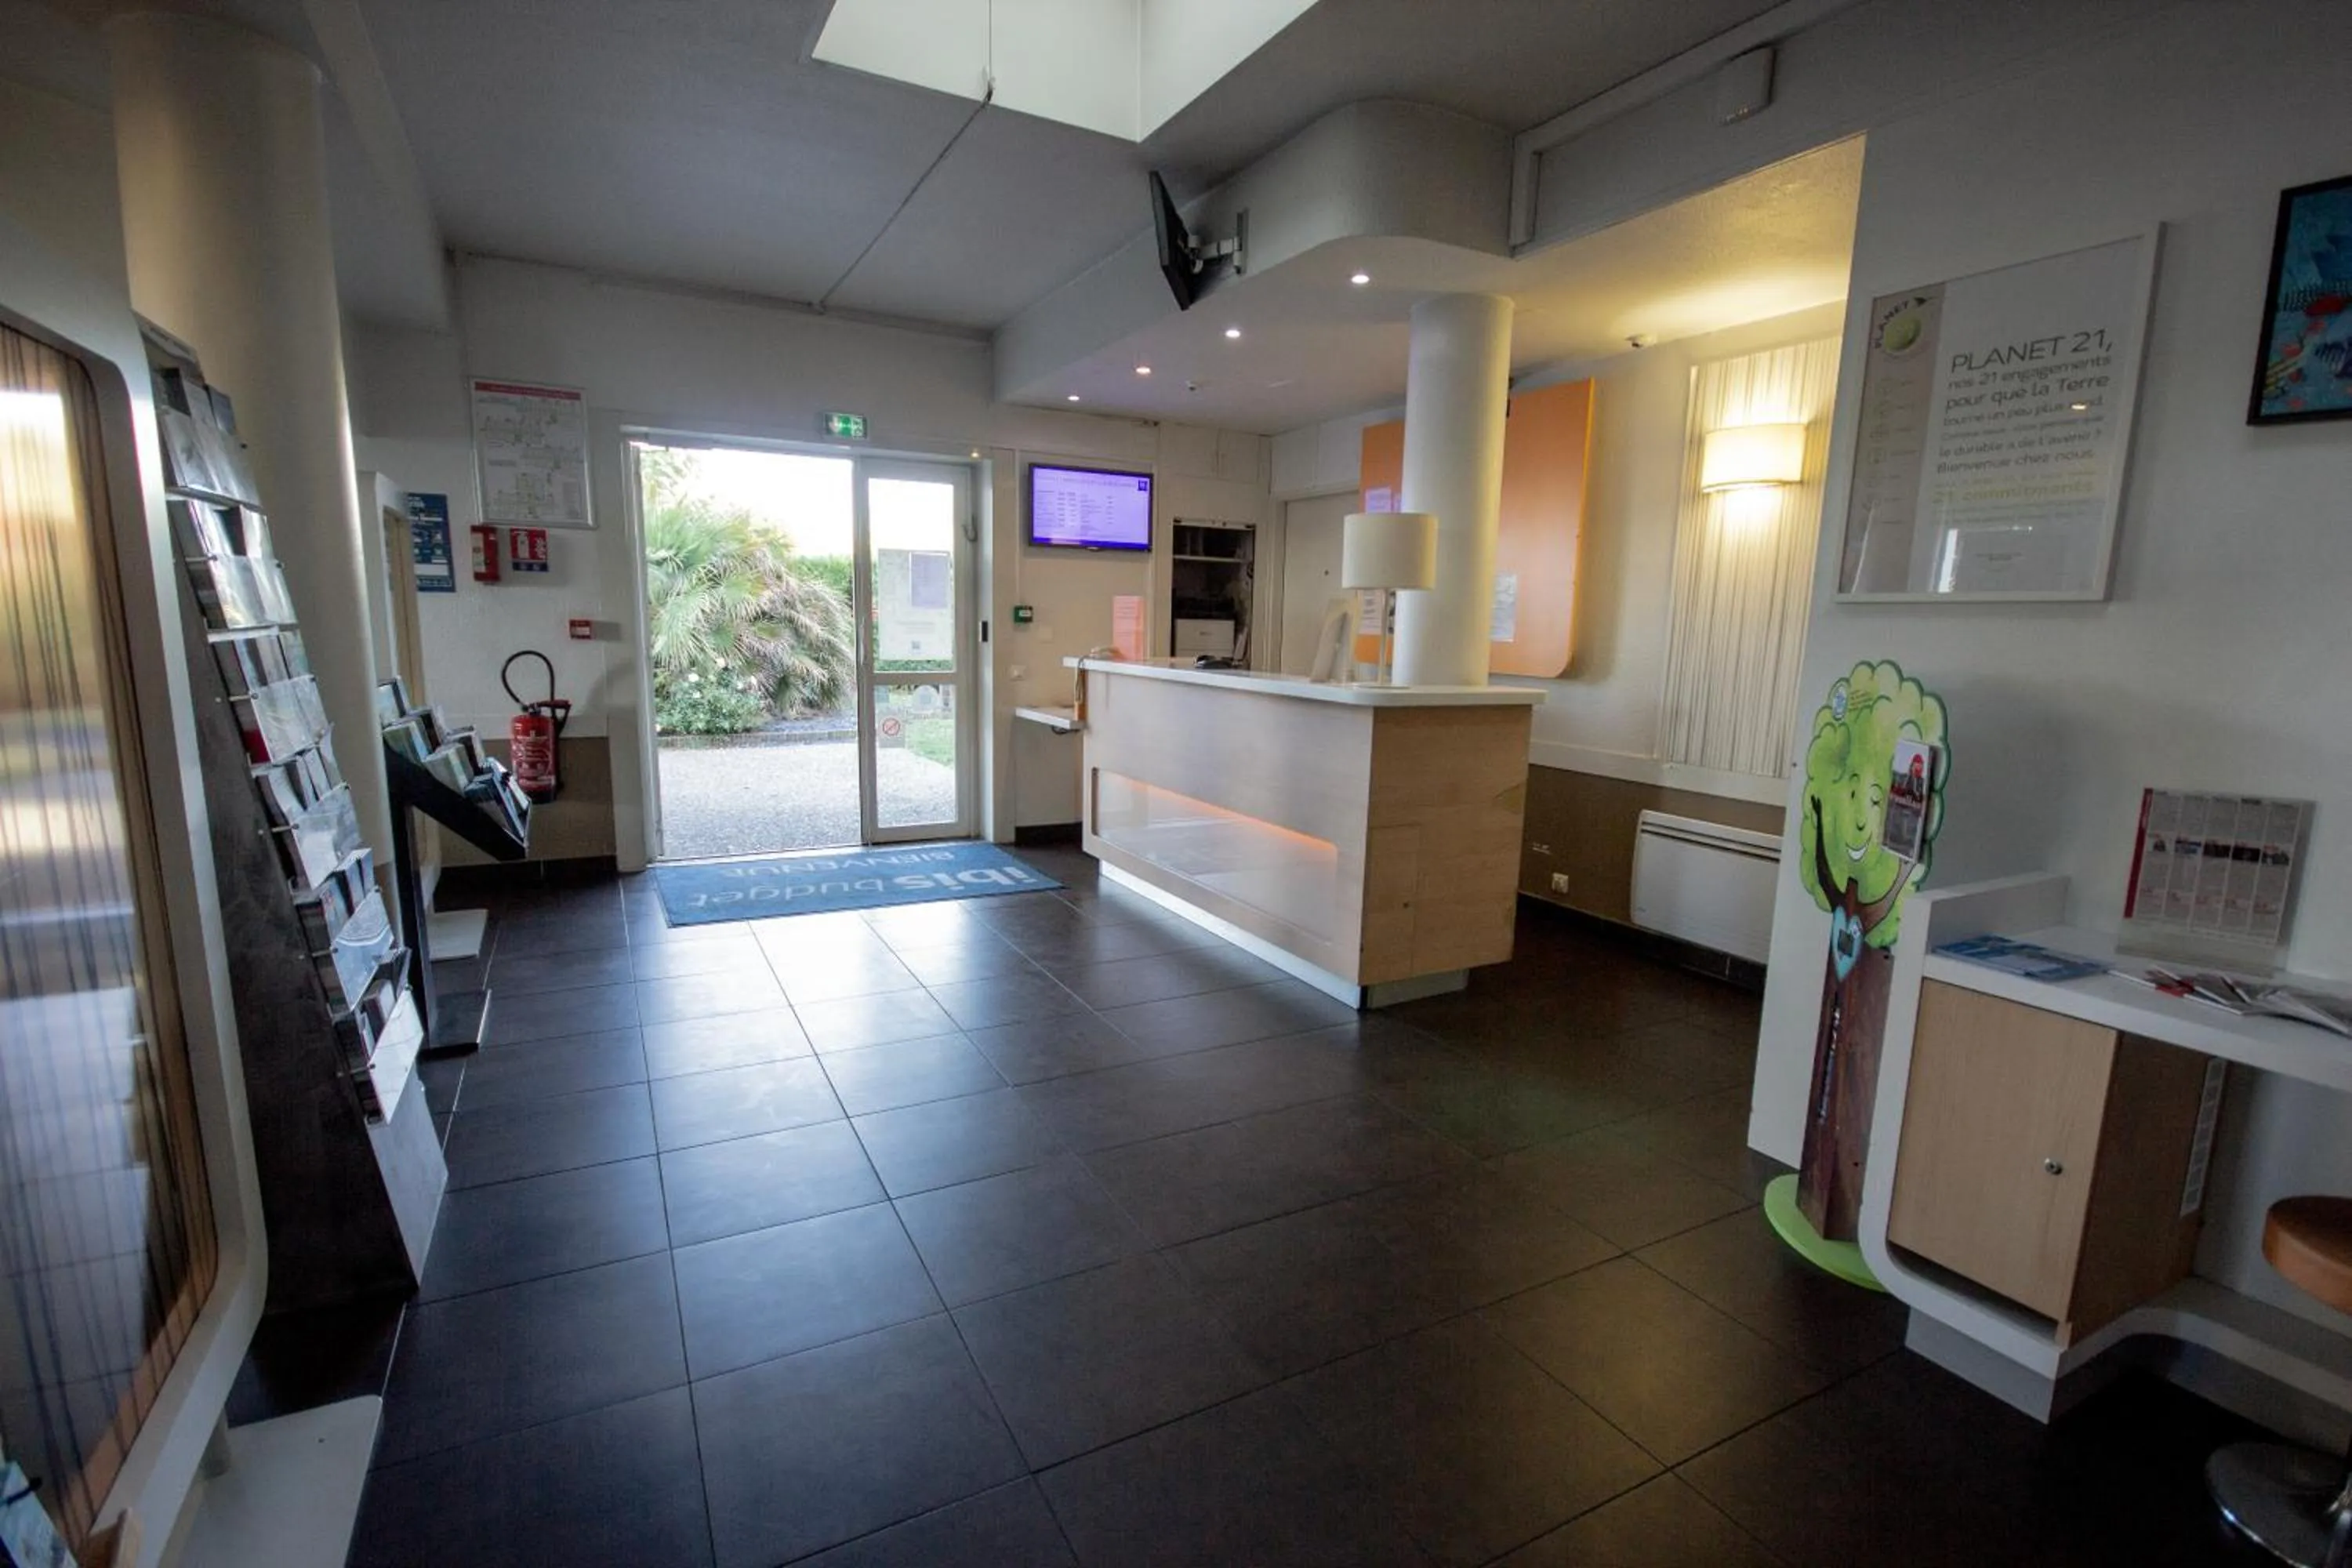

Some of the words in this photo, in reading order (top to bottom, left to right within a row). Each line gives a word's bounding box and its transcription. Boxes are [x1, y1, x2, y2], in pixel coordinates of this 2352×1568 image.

[1951, 336, 2067, 373] PLANET
[2070, 328, 2113, 353] 21,
[1947, 377, 1974, 390] nos
[1980, 371, 1998, 385] 21
[2001, 353, 2113, 383] engagements
[1944, 393, 1987, 414] pour
[1991, 388, 2028, 407] que
[2031, 381, 2050, 397] la
[2056, 375, 2111, 393] Terre
[720, 850, 956, 879] BIENVENUE
[891, 866, 1038, 892] ibis
[688, 877, 884, 908] budget
